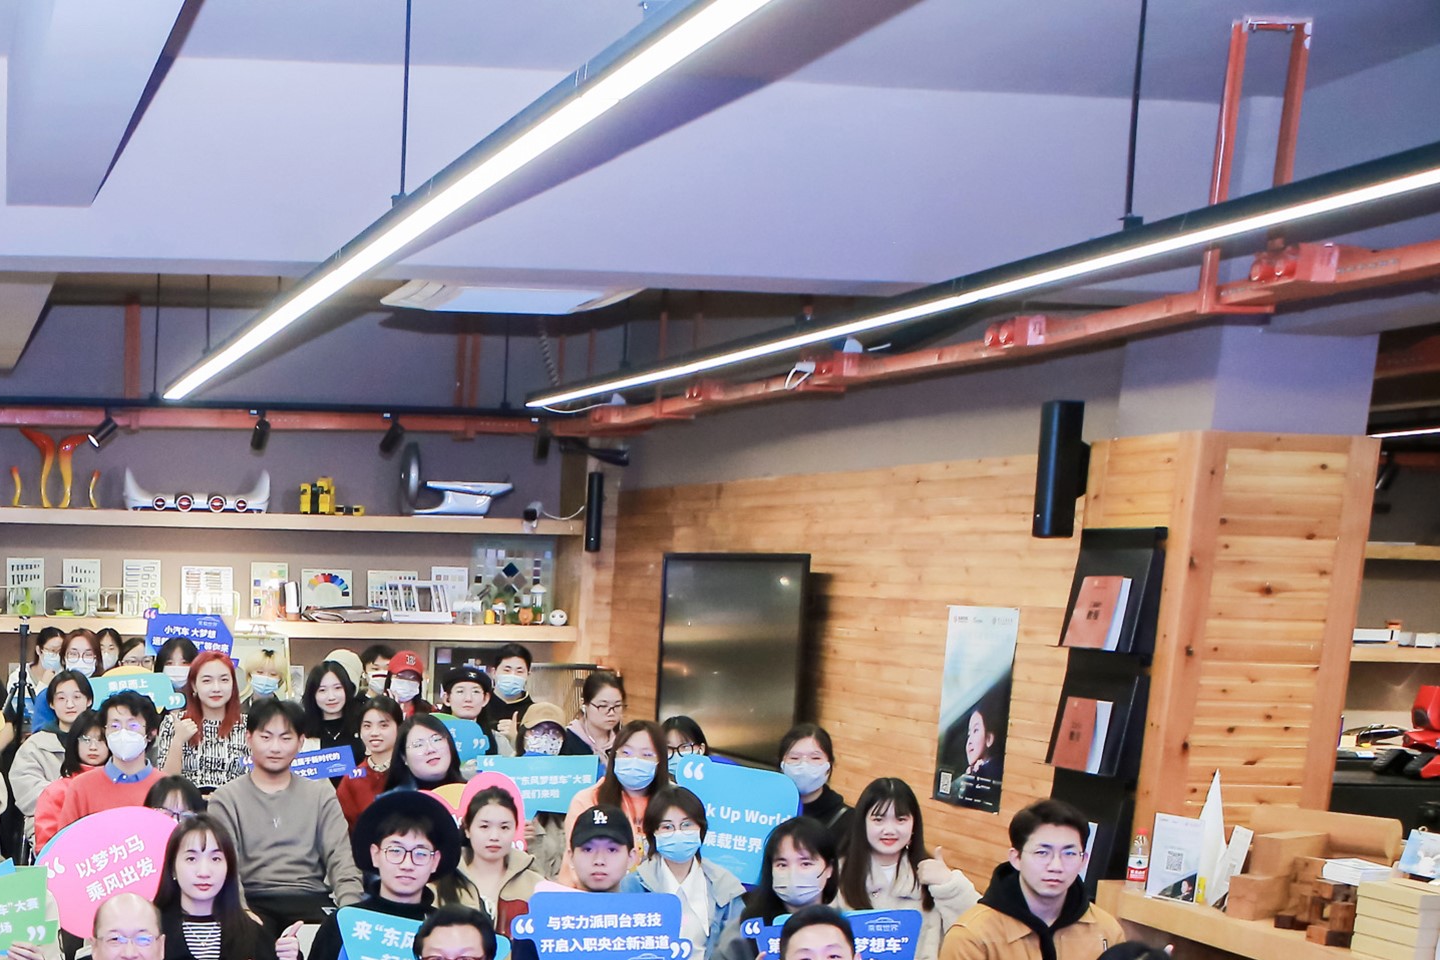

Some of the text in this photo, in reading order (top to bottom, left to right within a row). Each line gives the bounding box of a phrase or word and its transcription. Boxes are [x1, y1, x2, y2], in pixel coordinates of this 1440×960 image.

[720, 806, 741, 823] Up
[75, 834, 145, 879] 以梦为马
[86, 857, 157, 902] 乘风出发
[547, 912, 662, 930] 与实力派同台竞技
[540, 935, 670, 953] 开启入职央企新通道
